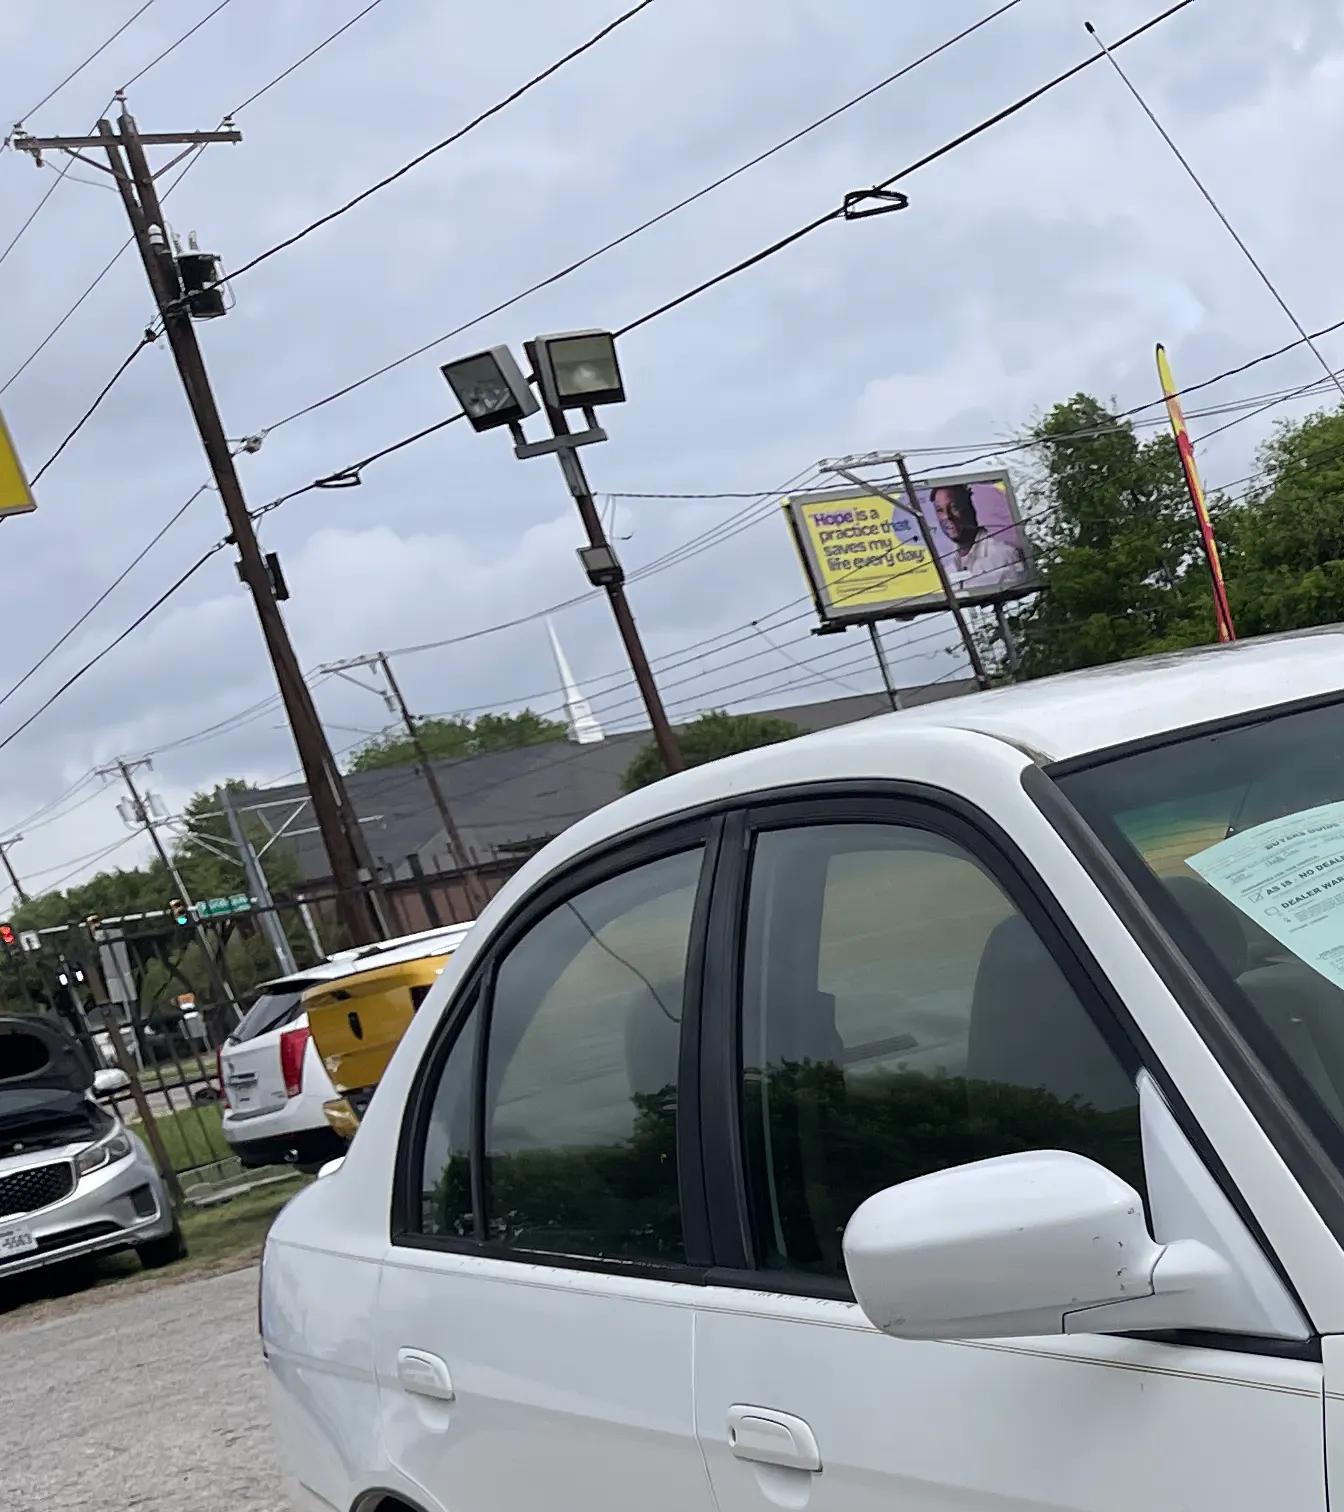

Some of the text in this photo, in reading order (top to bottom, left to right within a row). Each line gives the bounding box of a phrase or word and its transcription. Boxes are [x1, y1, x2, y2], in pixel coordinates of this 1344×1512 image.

[870, 509, 879, 519] a
[819, 523, 880, 545] practice
[823, 537, 892, 556] saves my
[827, 556, 851, 571] life
[853, 553, 895, 569] every
[1266, 886, 1280, 896] AS
[1281, 880, 1293, 888] IS
[1299, 869, 1315, 880] NO
[1281, 887, 1322, 909] DEALER
